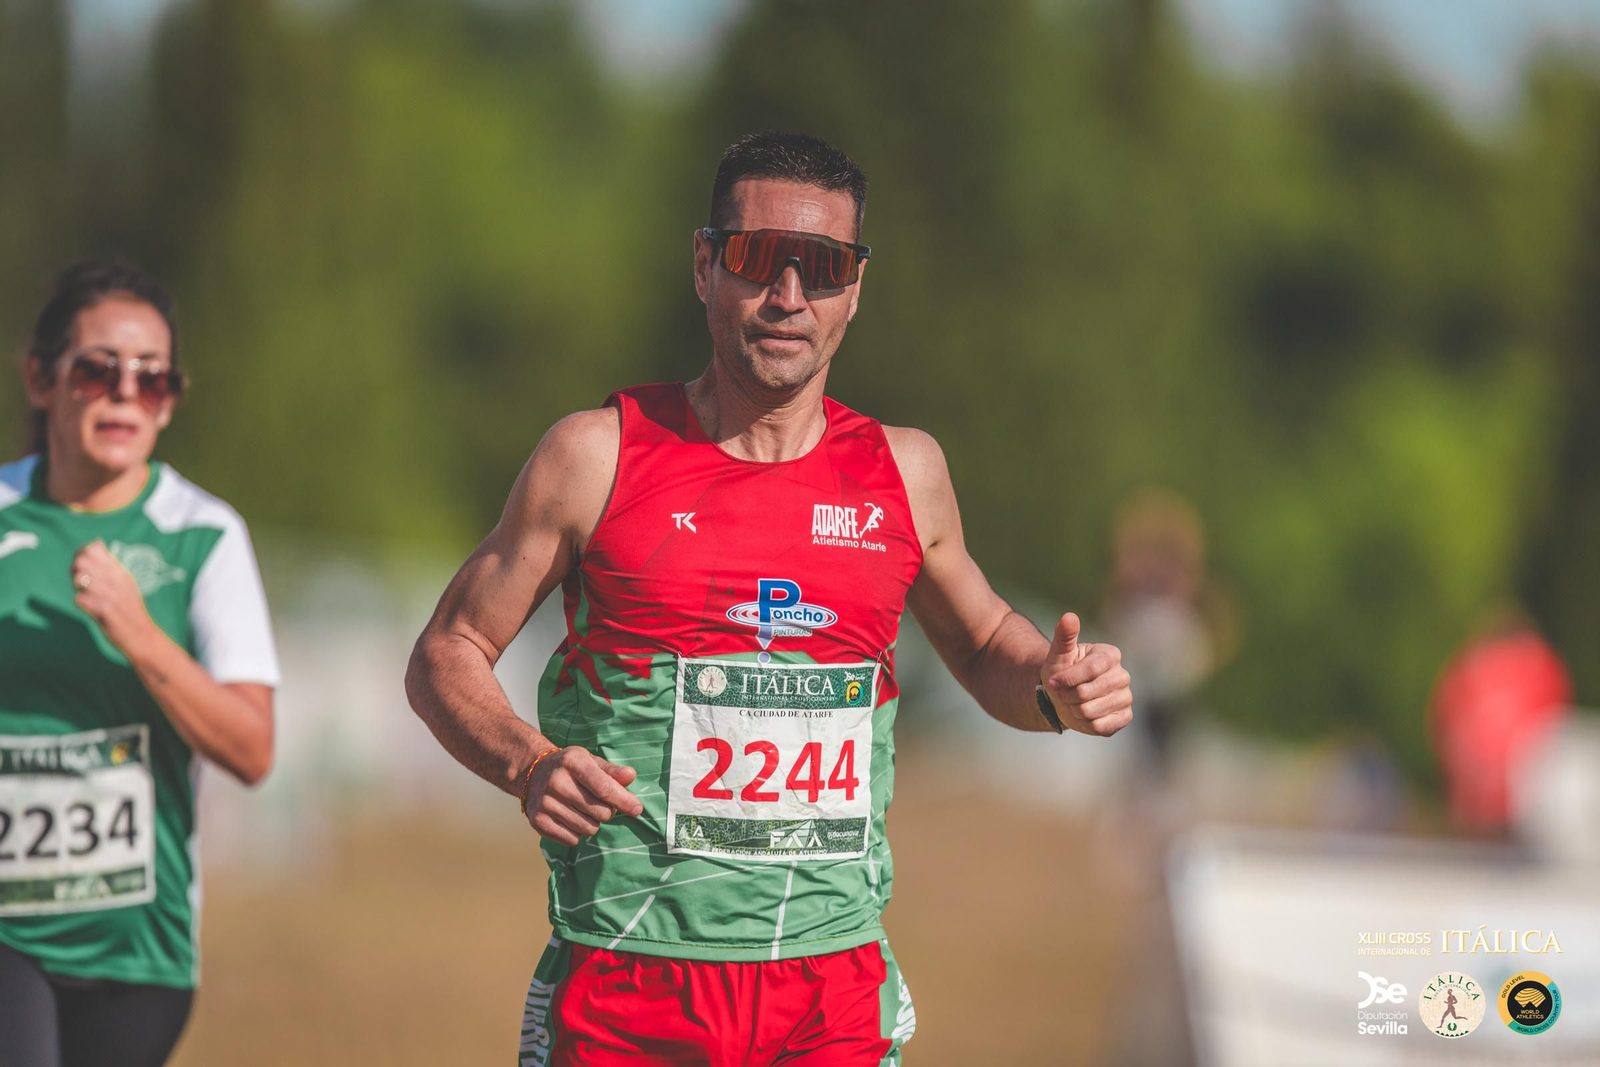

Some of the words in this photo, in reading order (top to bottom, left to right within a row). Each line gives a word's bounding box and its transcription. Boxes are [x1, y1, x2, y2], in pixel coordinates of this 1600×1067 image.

[811, 504, 859, 538] ATARFE
[812, 536, 859, 548] Atletismo
[861, 541, 887, 552] Atarfe
[758, 578, 824, 623] Poncho
[773, 628, 811, 636] PINTURAS
[741, 671, 836, 696] ITÁLICA
[739, 709, 752, 717] CA
[753, 710, 786, 718] CIUDAD
[692, 737, 860, 803] 2244
